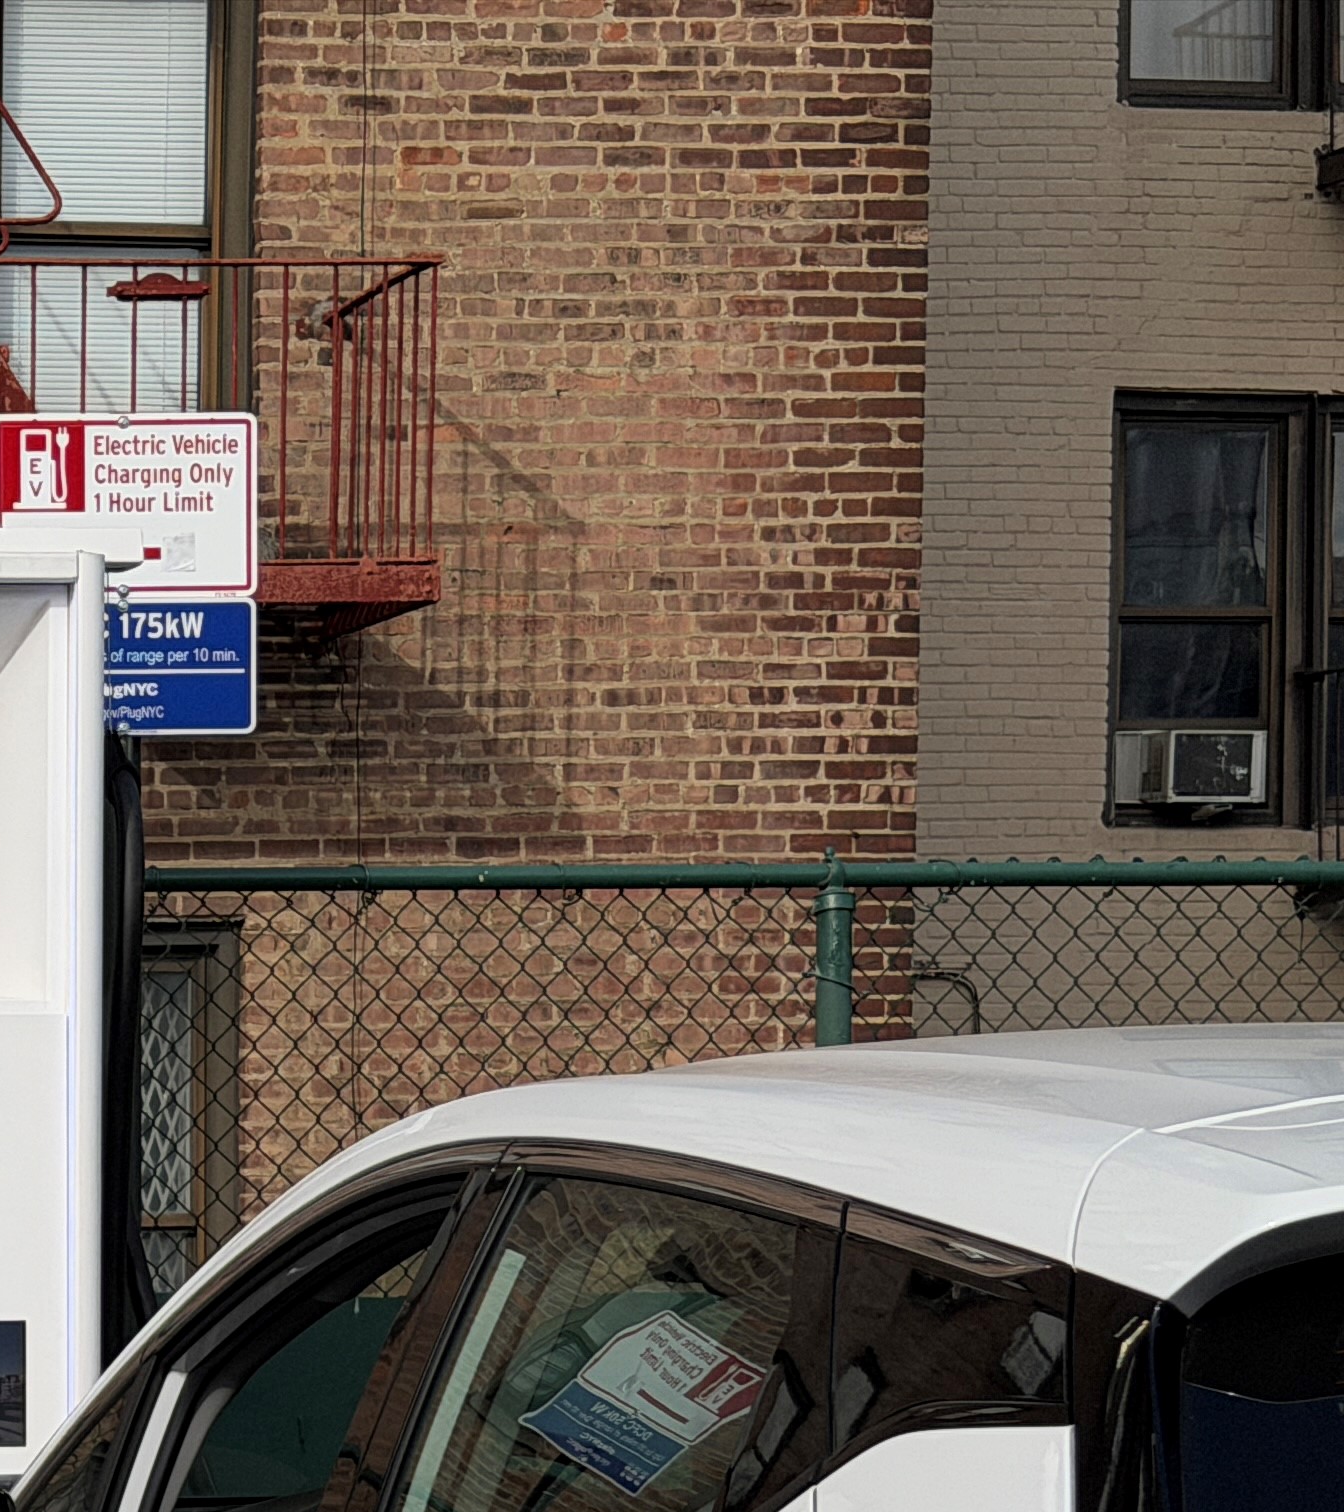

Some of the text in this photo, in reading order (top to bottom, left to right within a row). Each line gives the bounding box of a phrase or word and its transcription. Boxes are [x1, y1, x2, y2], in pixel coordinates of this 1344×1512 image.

[93, 433, 239, 456] Electric Vehicle
[29, 458, 42, 474] E
[94, 462, 234, 488] Charging Only
[28, 481, 43, 497] V
[93, 491, 214, 513] 1 Hour Limit
[119, 612, 204, 639] 175kW
[110, 648, 124, 662] of
[126, 650, 164, 666] range
[167, 650, 190, 666] per
[192, 648, 209, 662] 10
[212, 648, 241, 662] min.
